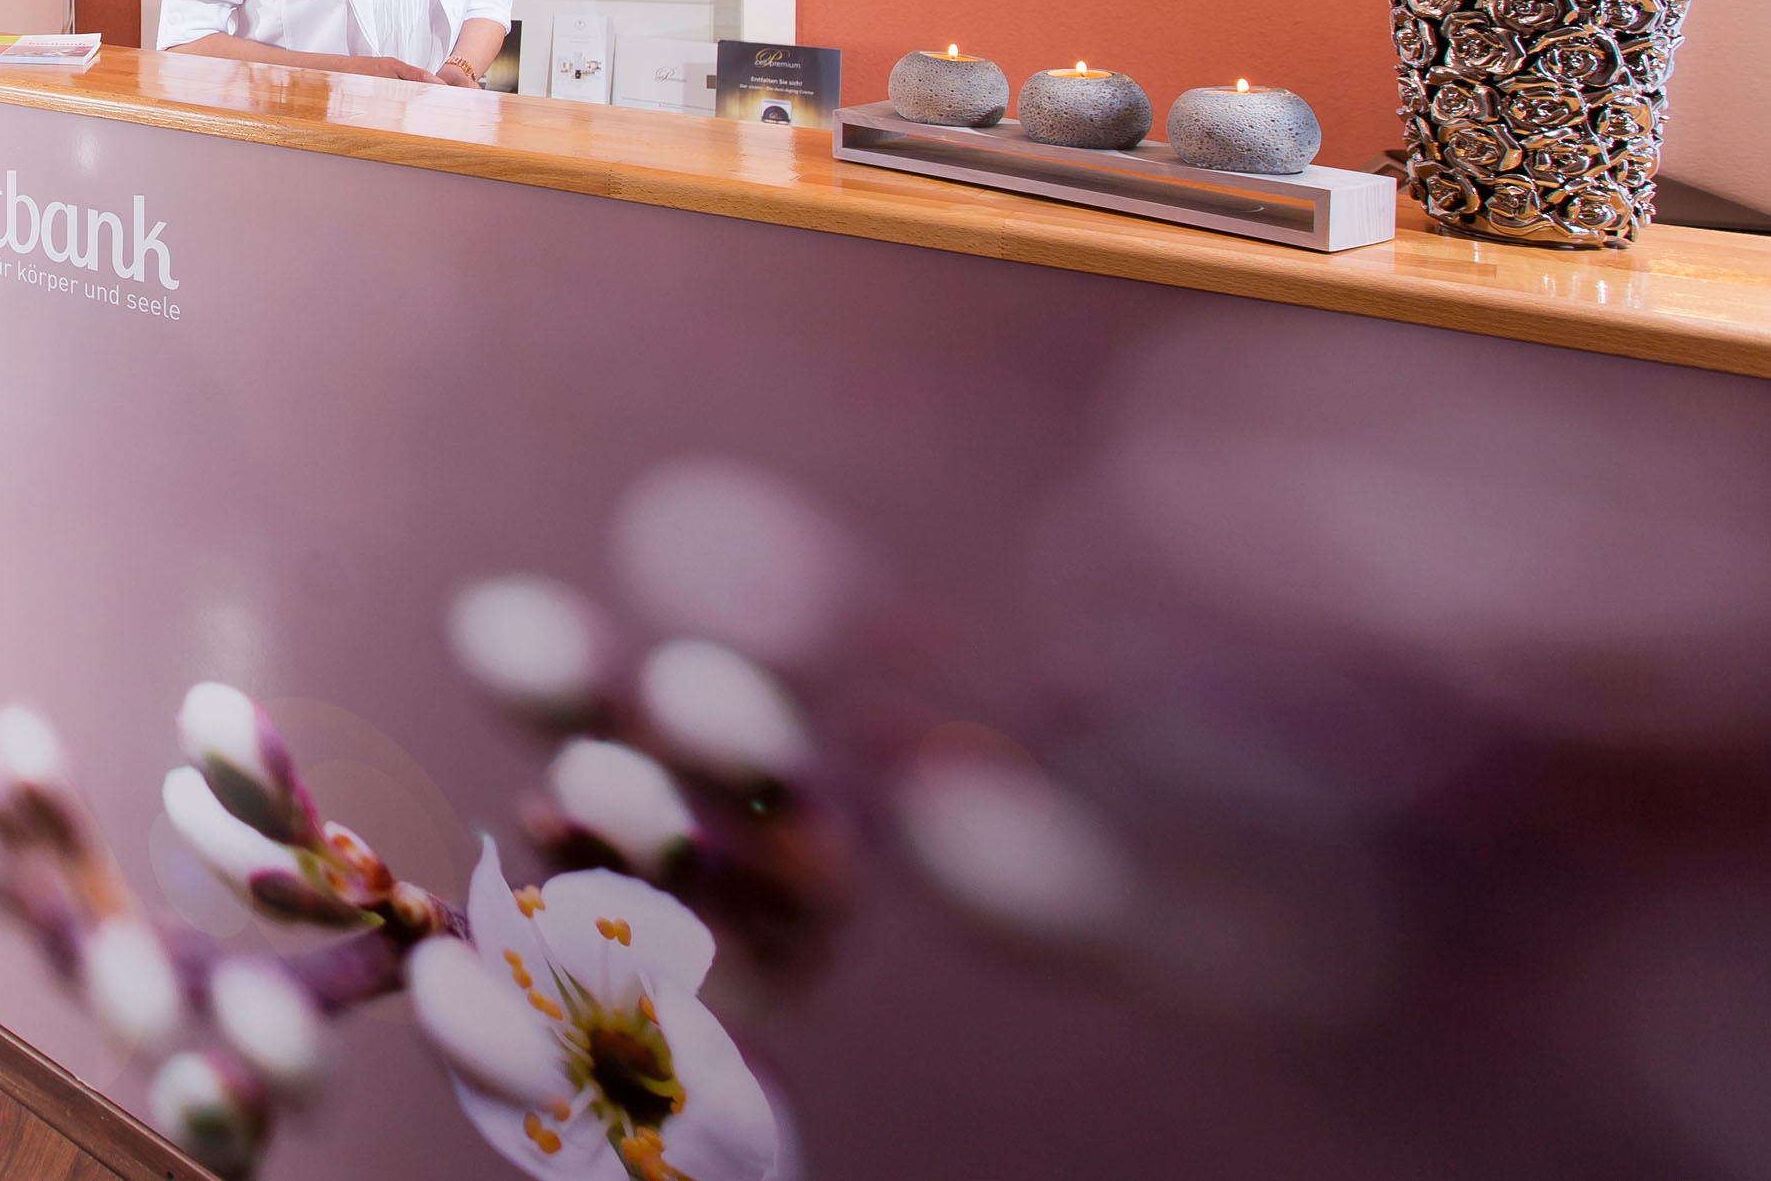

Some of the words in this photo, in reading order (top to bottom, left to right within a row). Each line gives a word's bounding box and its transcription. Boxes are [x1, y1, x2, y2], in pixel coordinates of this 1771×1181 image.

[750, 76, 778, 85] Entfalten
[779, 78, 788, 86] Sie
[18, 260, 79, 294] körper
[84, 284, 120, 306] und
[126, 292, 181, 321] seele
